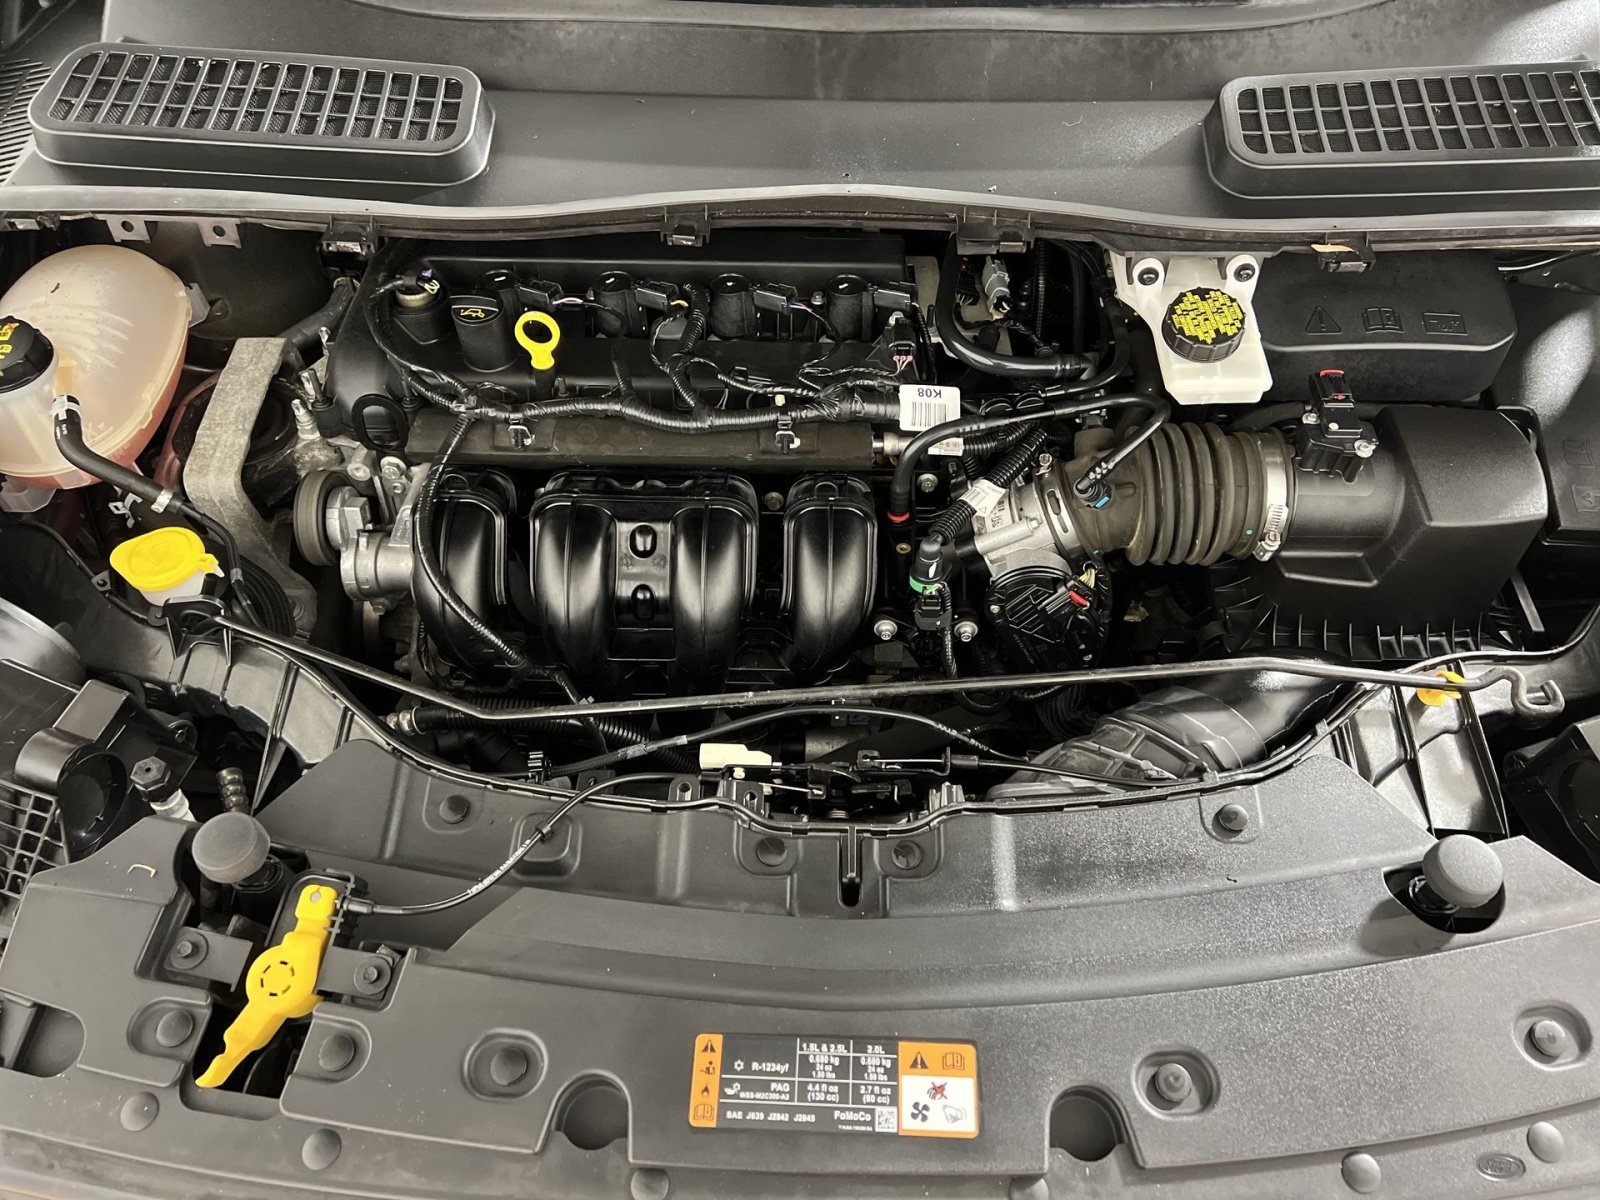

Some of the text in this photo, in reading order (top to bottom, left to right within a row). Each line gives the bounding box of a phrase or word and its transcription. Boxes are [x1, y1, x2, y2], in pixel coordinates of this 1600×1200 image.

[917, 387, 942, 399] K08
[802, 1043, 847, 1053] 1.5L & 2.5L
[867, 1045, 885, 1054] 2.0L
[830, 1055, 840, 1066] kg
[881, 1057, 891, 1068] kg
[751, 1061, 789, 1074] R-1234yf
[770, 1082, 790, 1092] PAG
[807, 1083, 820, 1092] 4.4
[828, 1085, 839, 1093] oz
[860, 1085, 873, 1094] 2.7
[881, 1087, 891, 1095] oz
[807, 1092, 840, 1103] (130 cc)
[877, 1095, 890, 1105] cc)
[726, 1111, 743, 1120] SAE
[834, 1110, 872, 1121] FoMoCo
